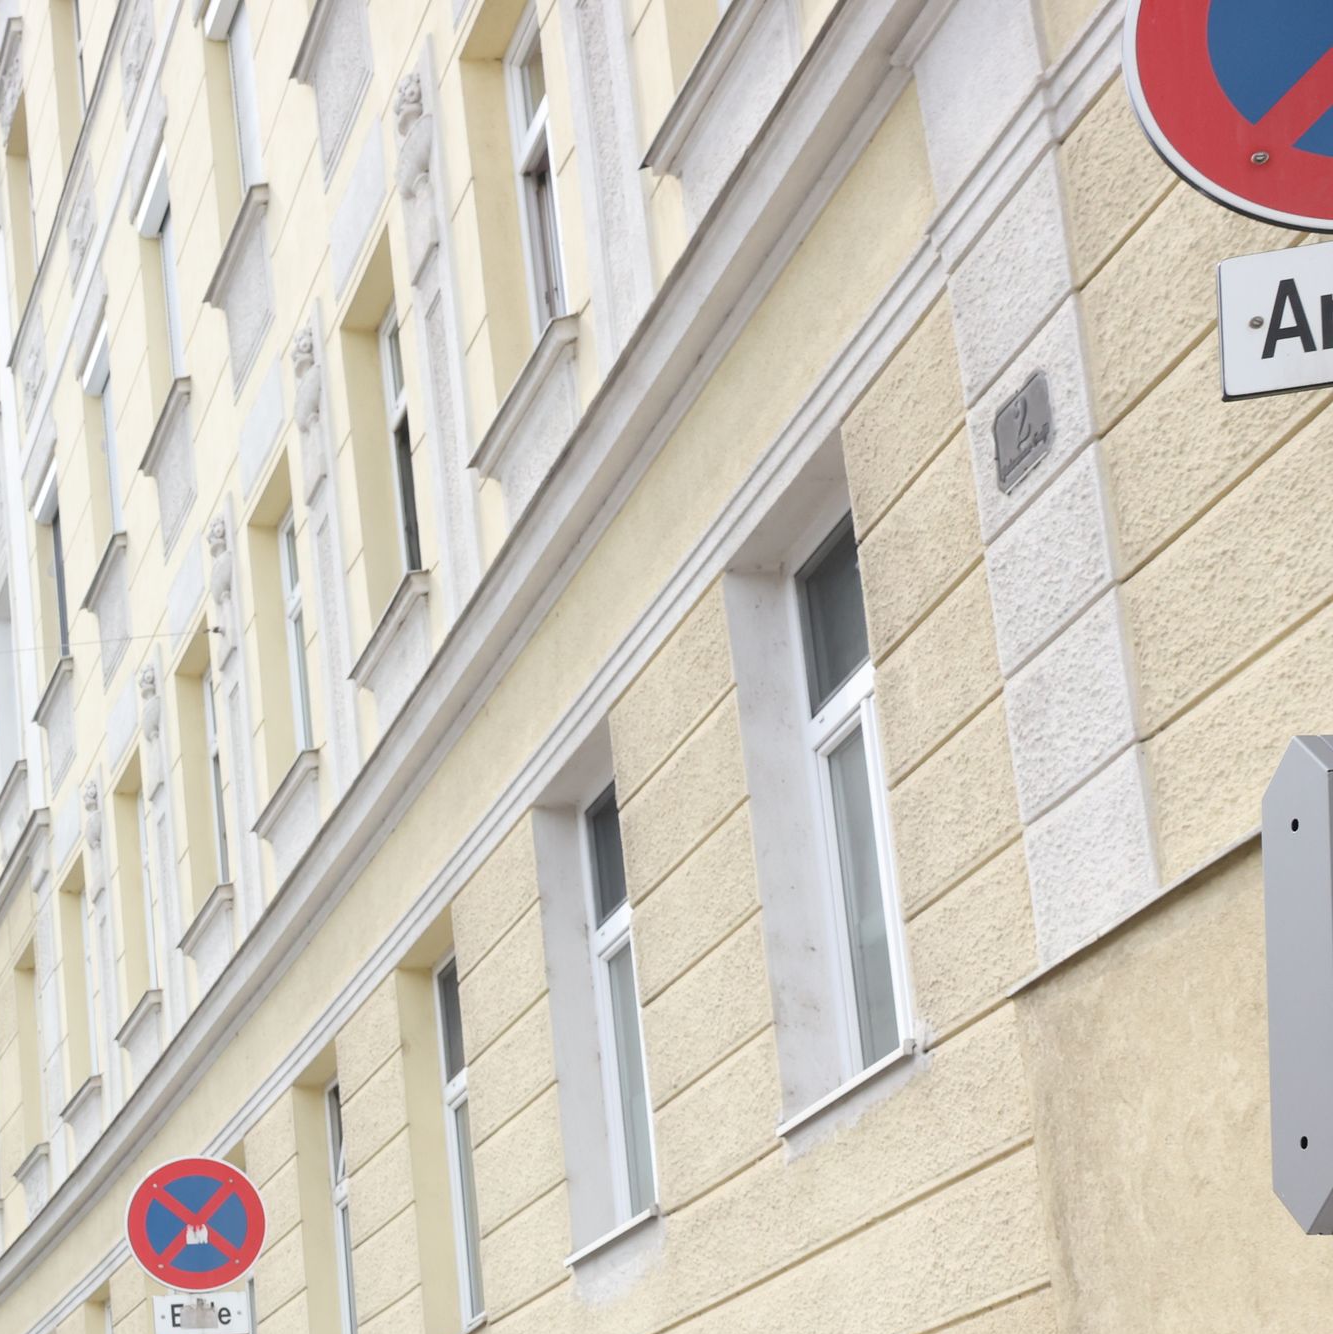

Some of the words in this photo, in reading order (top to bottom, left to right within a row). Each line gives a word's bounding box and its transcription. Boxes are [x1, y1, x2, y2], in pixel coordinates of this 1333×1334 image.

[1261, 278, 1333, 360] A
[1014, 396, 1032, 451] 2
[170, 1301, 232, 1328] Ee
